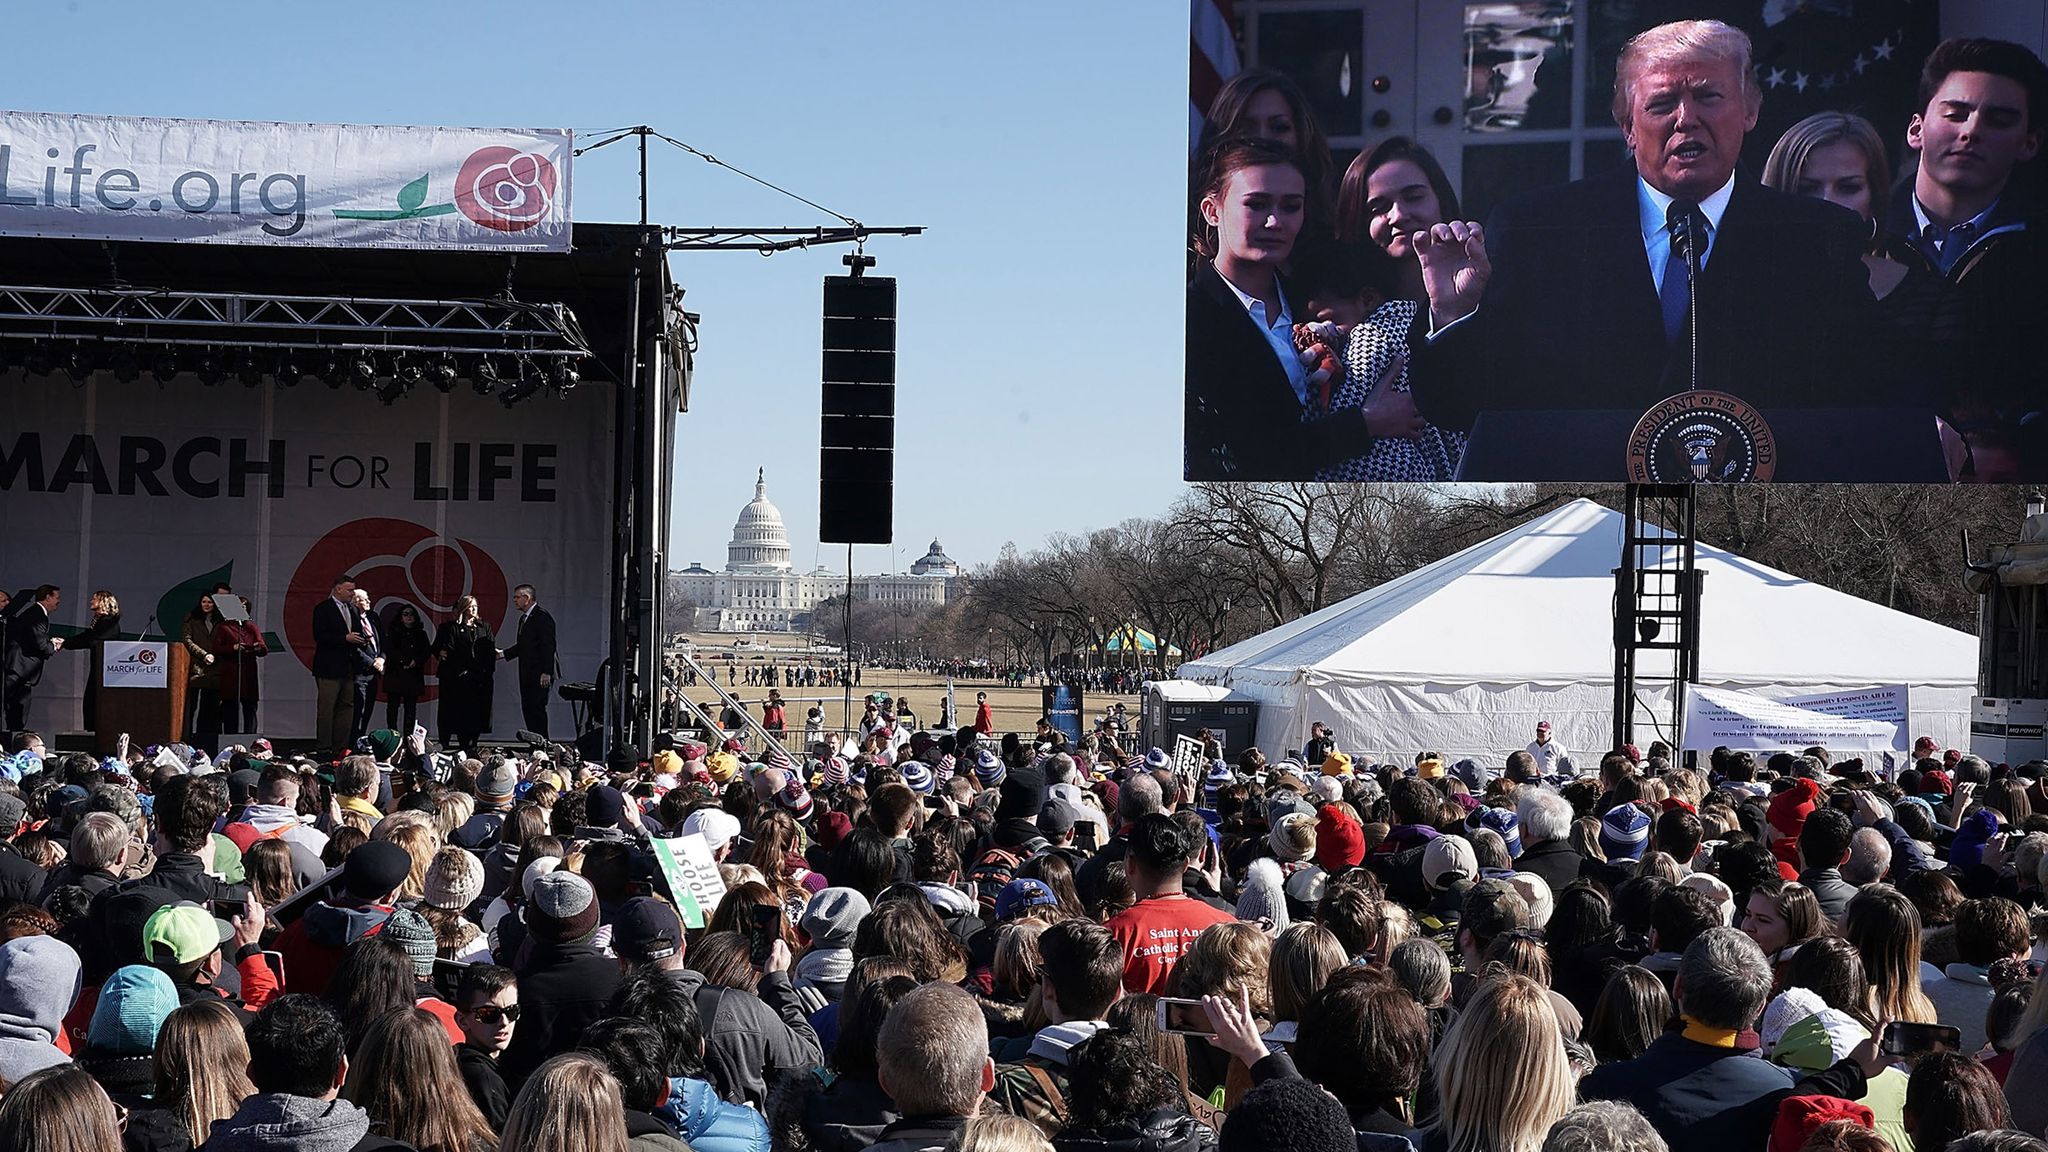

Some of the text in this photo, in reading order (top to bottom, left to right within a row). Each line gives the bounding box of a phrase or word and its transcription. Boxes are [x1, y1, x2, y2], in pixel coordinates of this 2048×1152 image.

[0, 144, 306, 237] Life.org
[1632, 395, 1772, 480] THE PRESIDENT OF THE UNITED
[0, 432, 557, 502] MARCH FOR LIFE
[107, 665, 134, 673] MARCH
[134, 666, 145, 675] for
[672, 849, 715, 912] HOOSE
[695, 862, 724, 896] LIFE
[1023, 881, 1037, 889] 24
[1133, 942, 1179, 958] Catholic
[1149, 928, 1179, 940] Saint
